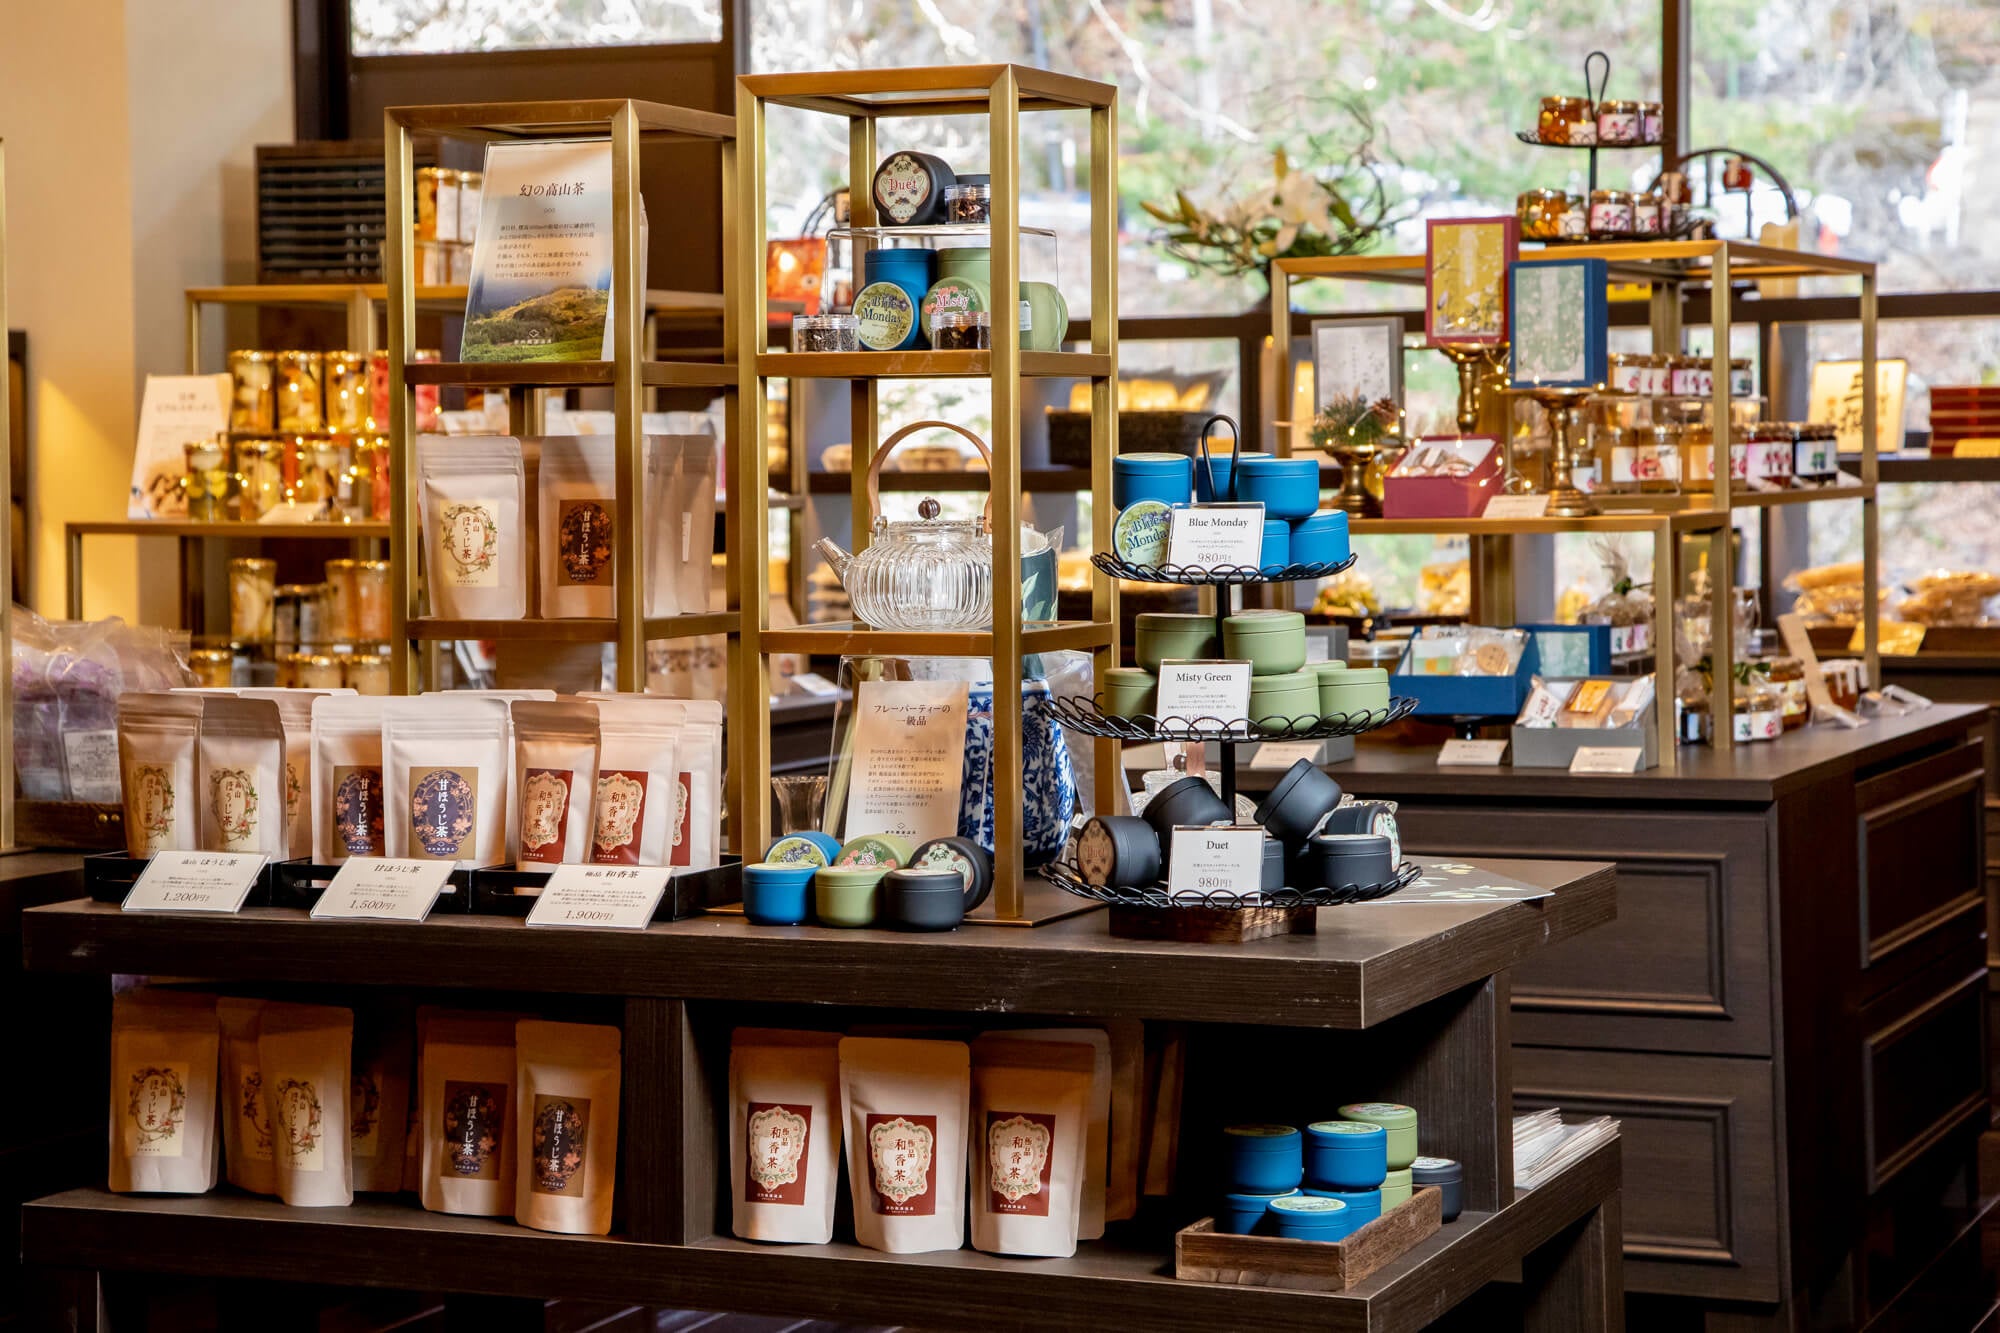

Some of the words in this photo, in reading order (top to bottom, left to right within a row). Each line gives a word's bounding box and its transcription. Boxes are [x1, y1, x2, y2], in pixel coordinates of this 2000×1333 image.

[519, 182, 586, 197] 幻の高山茶
[888, 177, 917, 191] Duet
[862, 308, 903, 326] Monday
[936, 295, 969, 311] Misty
[463, 516, 472, 560] ほうじ茶
[578, 510, 592, 566] 甘ほうじ茶
[1131, 516, 1159, 534] Blue
[1189, 517, 1209, 527] Blue
[1210, 517, 1249, 528] Monday
[1126, 529, 1169, 551] Monda
[1176, 672, 1202, 684] Misty
[1204, 672, 1232, 682] Green
[873, 704, 951, 714] フレーバーティーの
[896, 715, 927, 726] 一級品
[223, 781, 233, 827] ほうじ茶
[356, 777, 370, 837] 甘ほうじ茶
[436, 778, 449, 838] 甘ほうじ茶
[533, 790, 547, 830] 和香茶
[606, 791, 620, 831] 和香茶
[1206, 840, 1229, 850] Duet
[374, 864, 423, 874] 甘ほうじ茶
[606, 870, 640, 879] 和香茶
[146, 1080, 159, 1126] ほうじ茶
[463, 1095, 478, 1156] 甘ほうじ茶
[548, 1110, 565, 1173] 甘ほうじ茶
[767, 1126, 782, 1169] 和香茶
[894, 1138, 906, 1182] 和香茶
[1009, 1136, 1023, 1180] 和香茶
